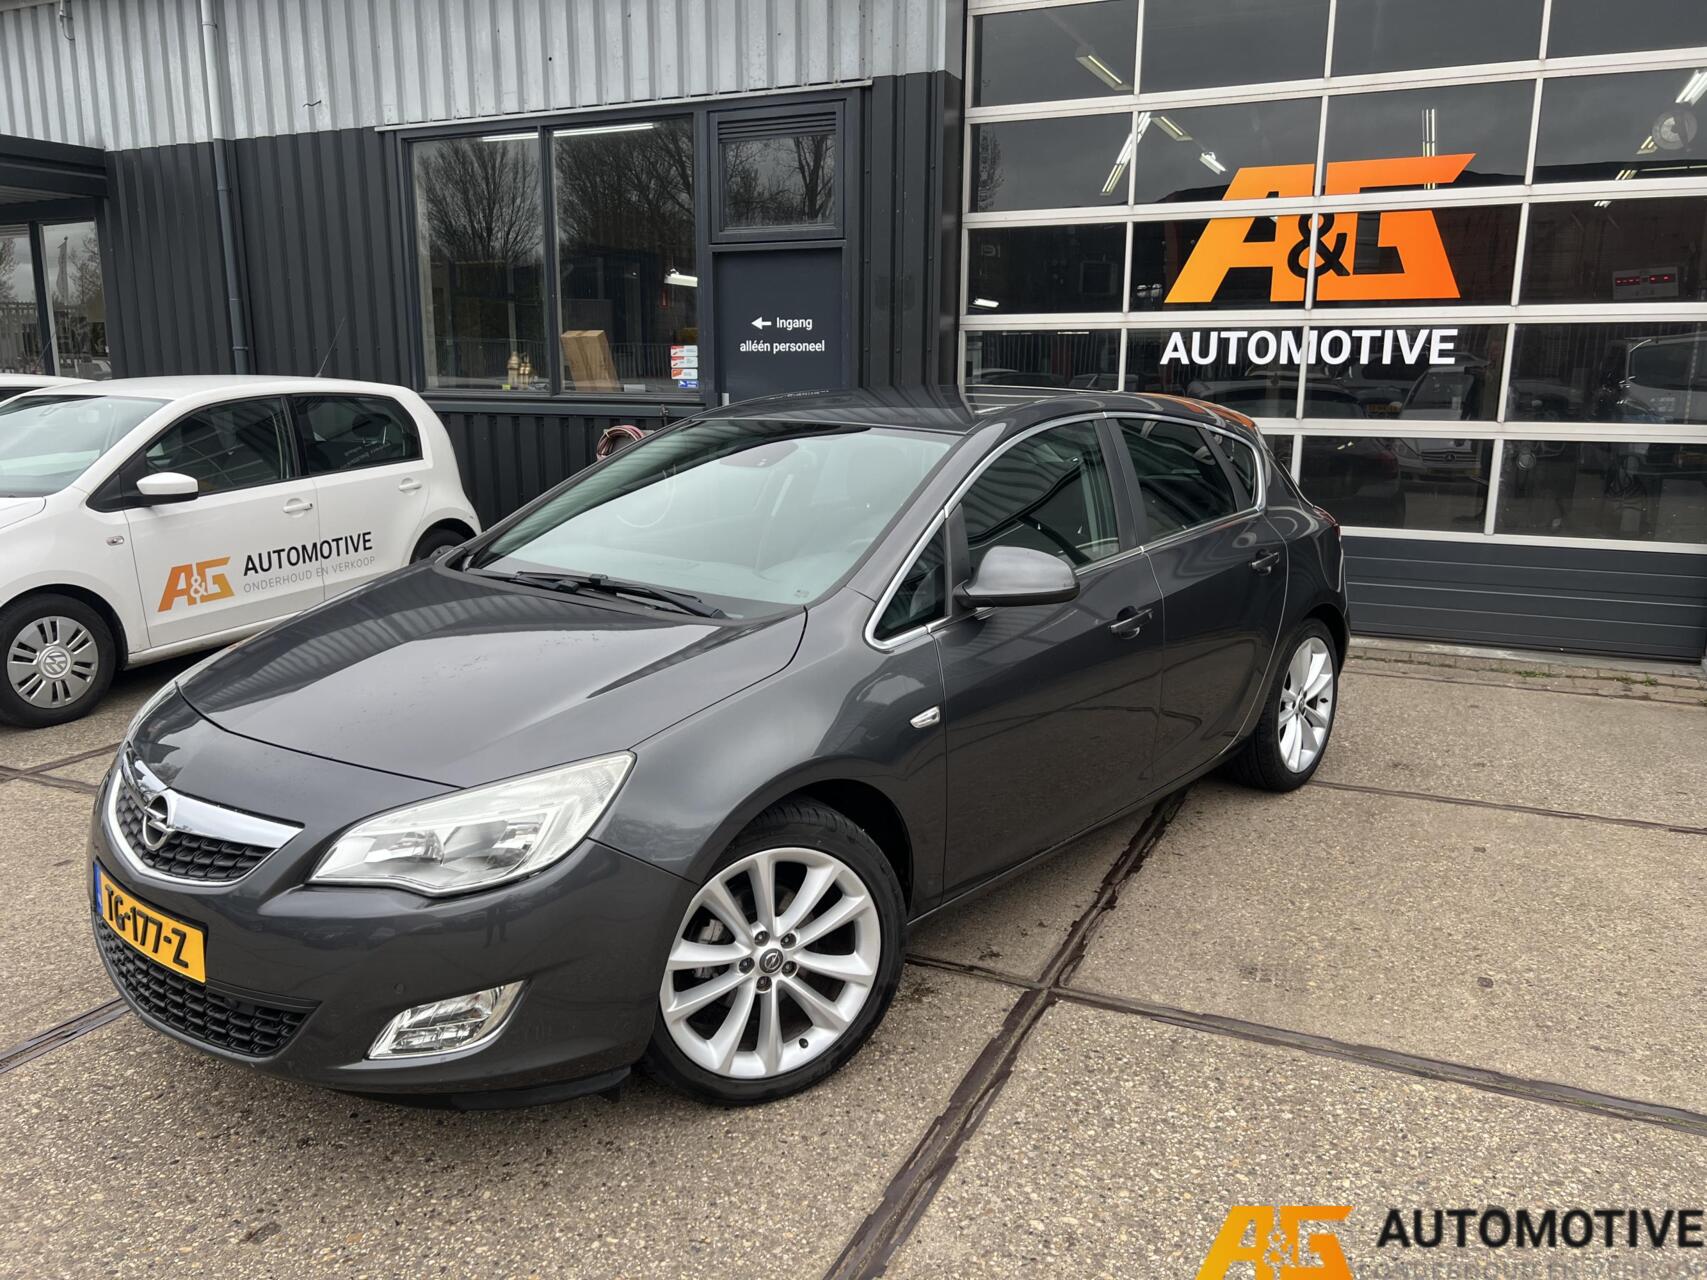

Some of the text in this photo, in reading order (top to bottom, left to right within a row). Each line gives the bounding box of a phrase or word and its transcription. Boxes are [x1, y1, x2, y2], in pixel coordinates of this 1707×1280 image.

[1164, 153, 1476, 303] A&G
[776, 317, 813, 330] Ingang
[740, 340, 825, 354] alléén personeel
[1160, 328, 1459, 365] AUTOMOTIVE
[243, 531, 373, 577] AUTOMOTIVE
[243, 556, 376, 593] ONDERHOUD EN VERKOOP
[157, 556, 236, 612] A&G
[105, 884, 189, 969] TG-177-Z
